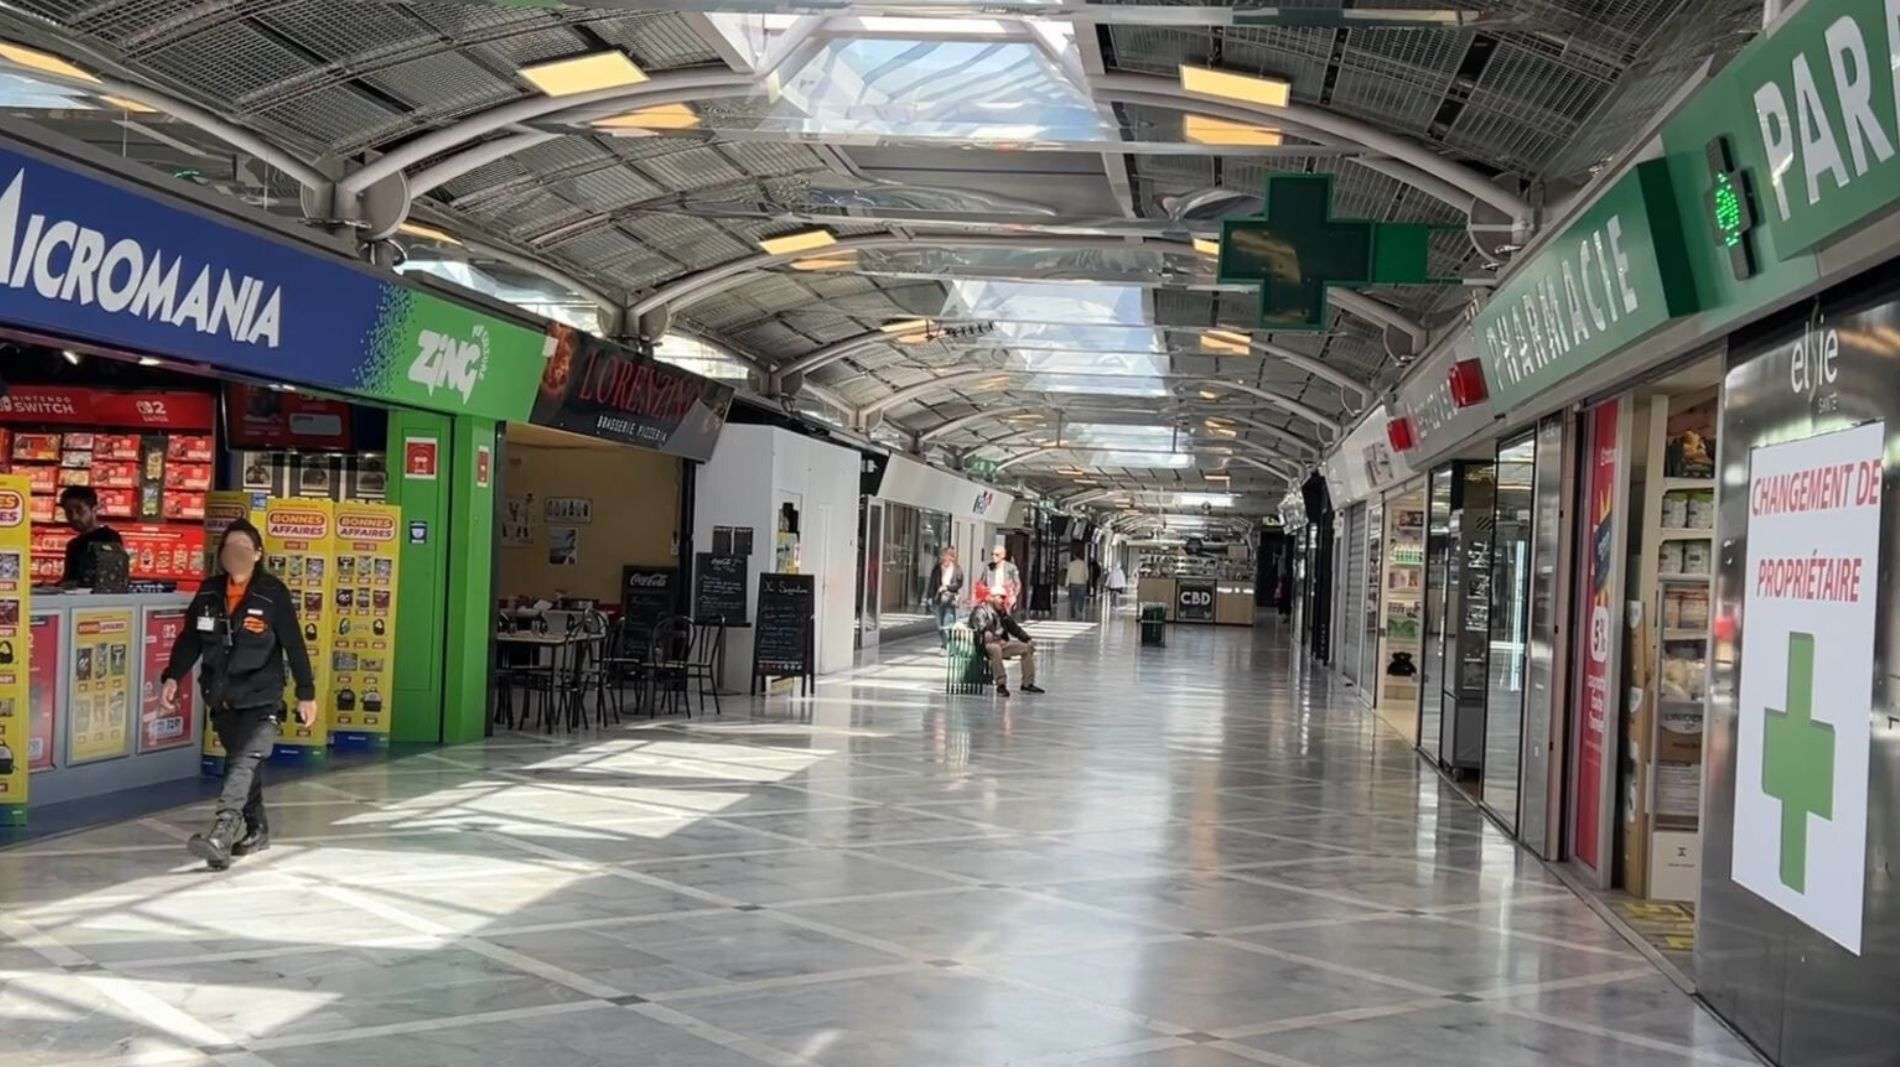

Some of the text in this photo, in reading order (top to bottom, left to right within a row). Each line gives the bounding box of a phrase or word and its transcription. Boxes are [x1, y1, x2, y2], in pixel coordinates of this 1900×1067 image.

[1486, 214, 1638, 391] PHARMACIE
[14, 402, 75, 414] SWITCH
[1752, 458, 1883, 516] CHANGEMENT DE
[270, 512, 323, 525] BONNES
[341, 515, 391, 527] BONNES
[271, 524, 324, 536] AFFAIRES
[339, 528, 392, 539] AFFAIRES
[1756, 549, 1862, 602] PROPRIÉTAIRE
[1180, 591, 1211, 606] CBD
